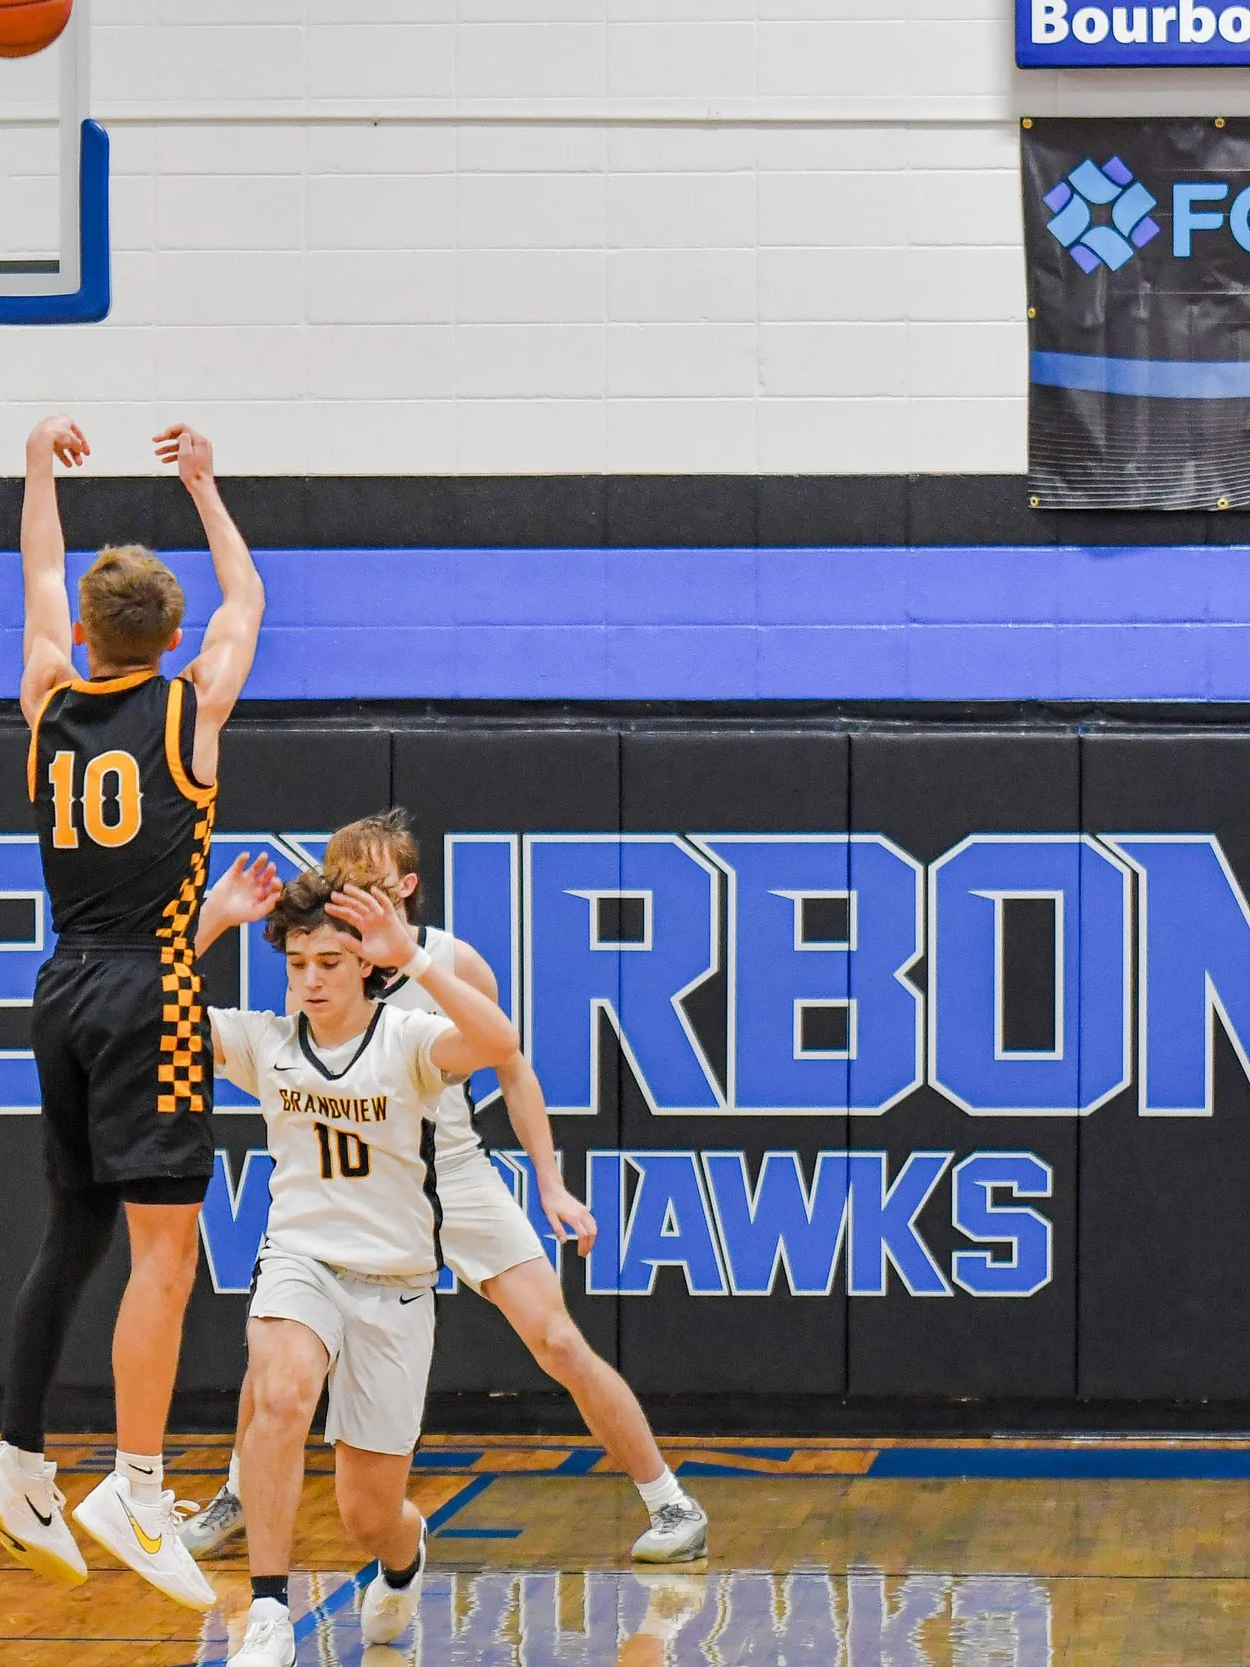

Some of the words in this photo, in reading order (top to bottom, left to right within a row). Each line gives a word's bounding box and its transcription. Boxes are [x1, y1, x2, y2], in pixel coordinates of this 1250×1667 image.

[1031, 0, 1250, 44] Bourbo
[48, 749, 144, 849] 10
[278, 1087, 387, 1122] GRANDVIEW
[312, 1119, 372, 1180] 10
